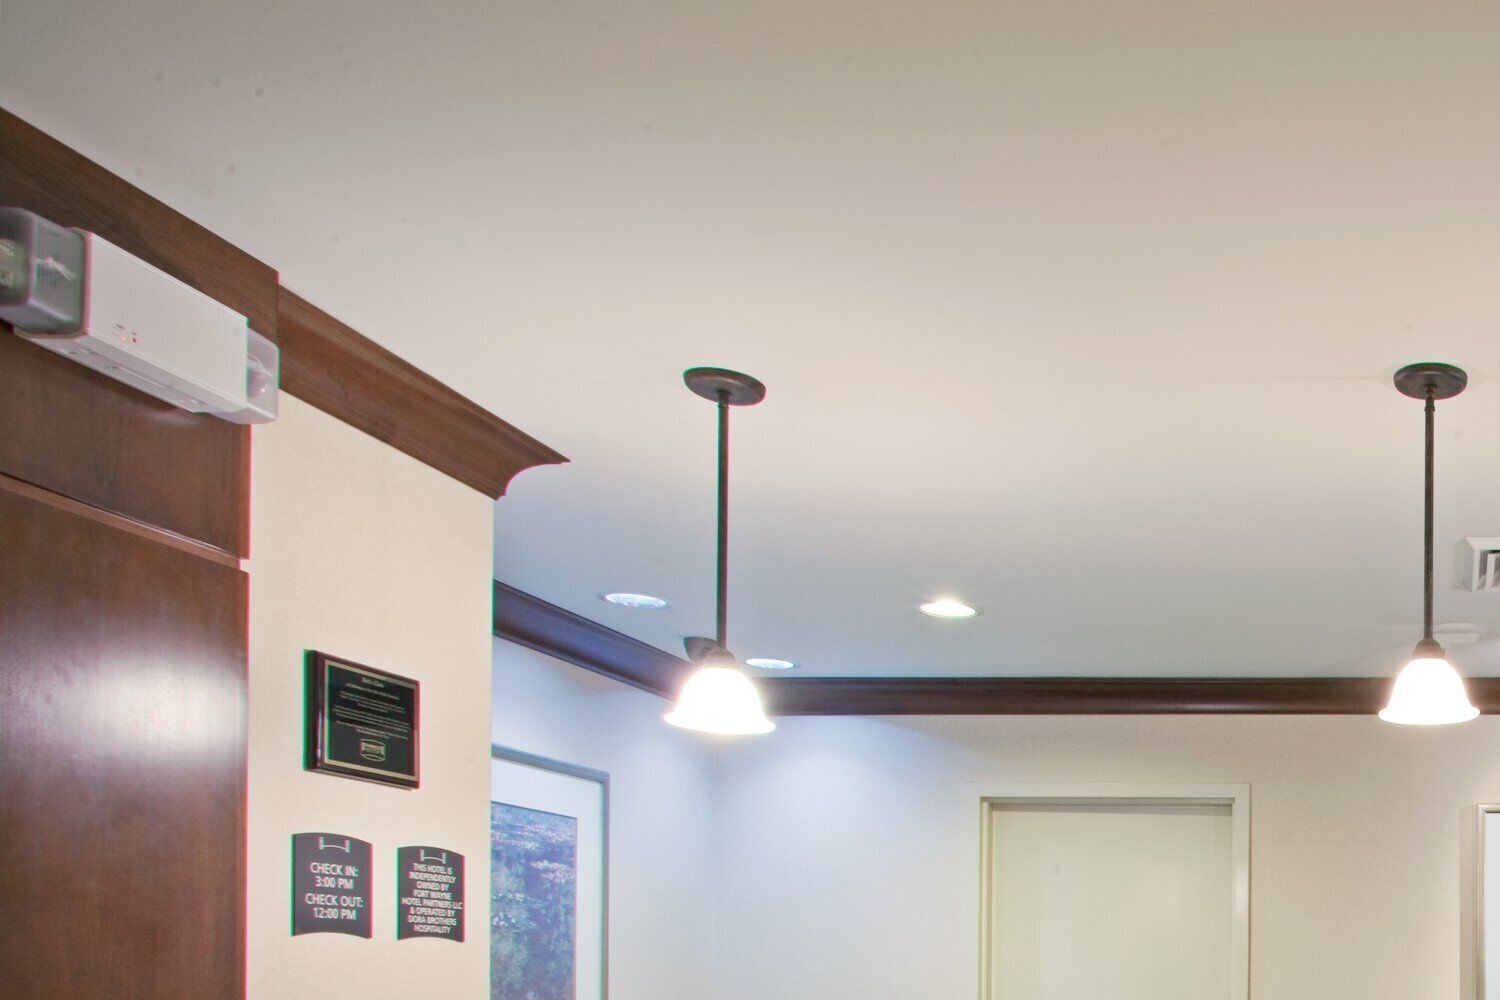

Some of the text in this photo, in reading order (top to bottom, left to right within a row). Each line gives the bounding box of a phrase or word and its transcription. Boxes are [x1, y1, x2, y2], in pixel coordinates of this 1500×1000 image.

[310, 862, 359, 877] CHECK IN:
[413, 863, 453, 875] THIS HOTEL IS
[314, 875, 354, 890] 3:00 PM
[409, 871, 456, 883] INDEPENDENTLY
[416, 881, 450, 891] OWNED BY
[305, 893, 363, 908] CHECK OUT:
[413, 889, 452, 900] FORT WAYNE
[401, 897, 463, 910] HOTEL PARTNERS LLC
[313, 907, 357, 921] 12:00 PM
[416, 907, 447, 917] OPERATED
[447, 909, 456, 917] BY
[427, 916, 457, 926] BROTHERS
[414, 924, 452, 934] HOSPITALITY
